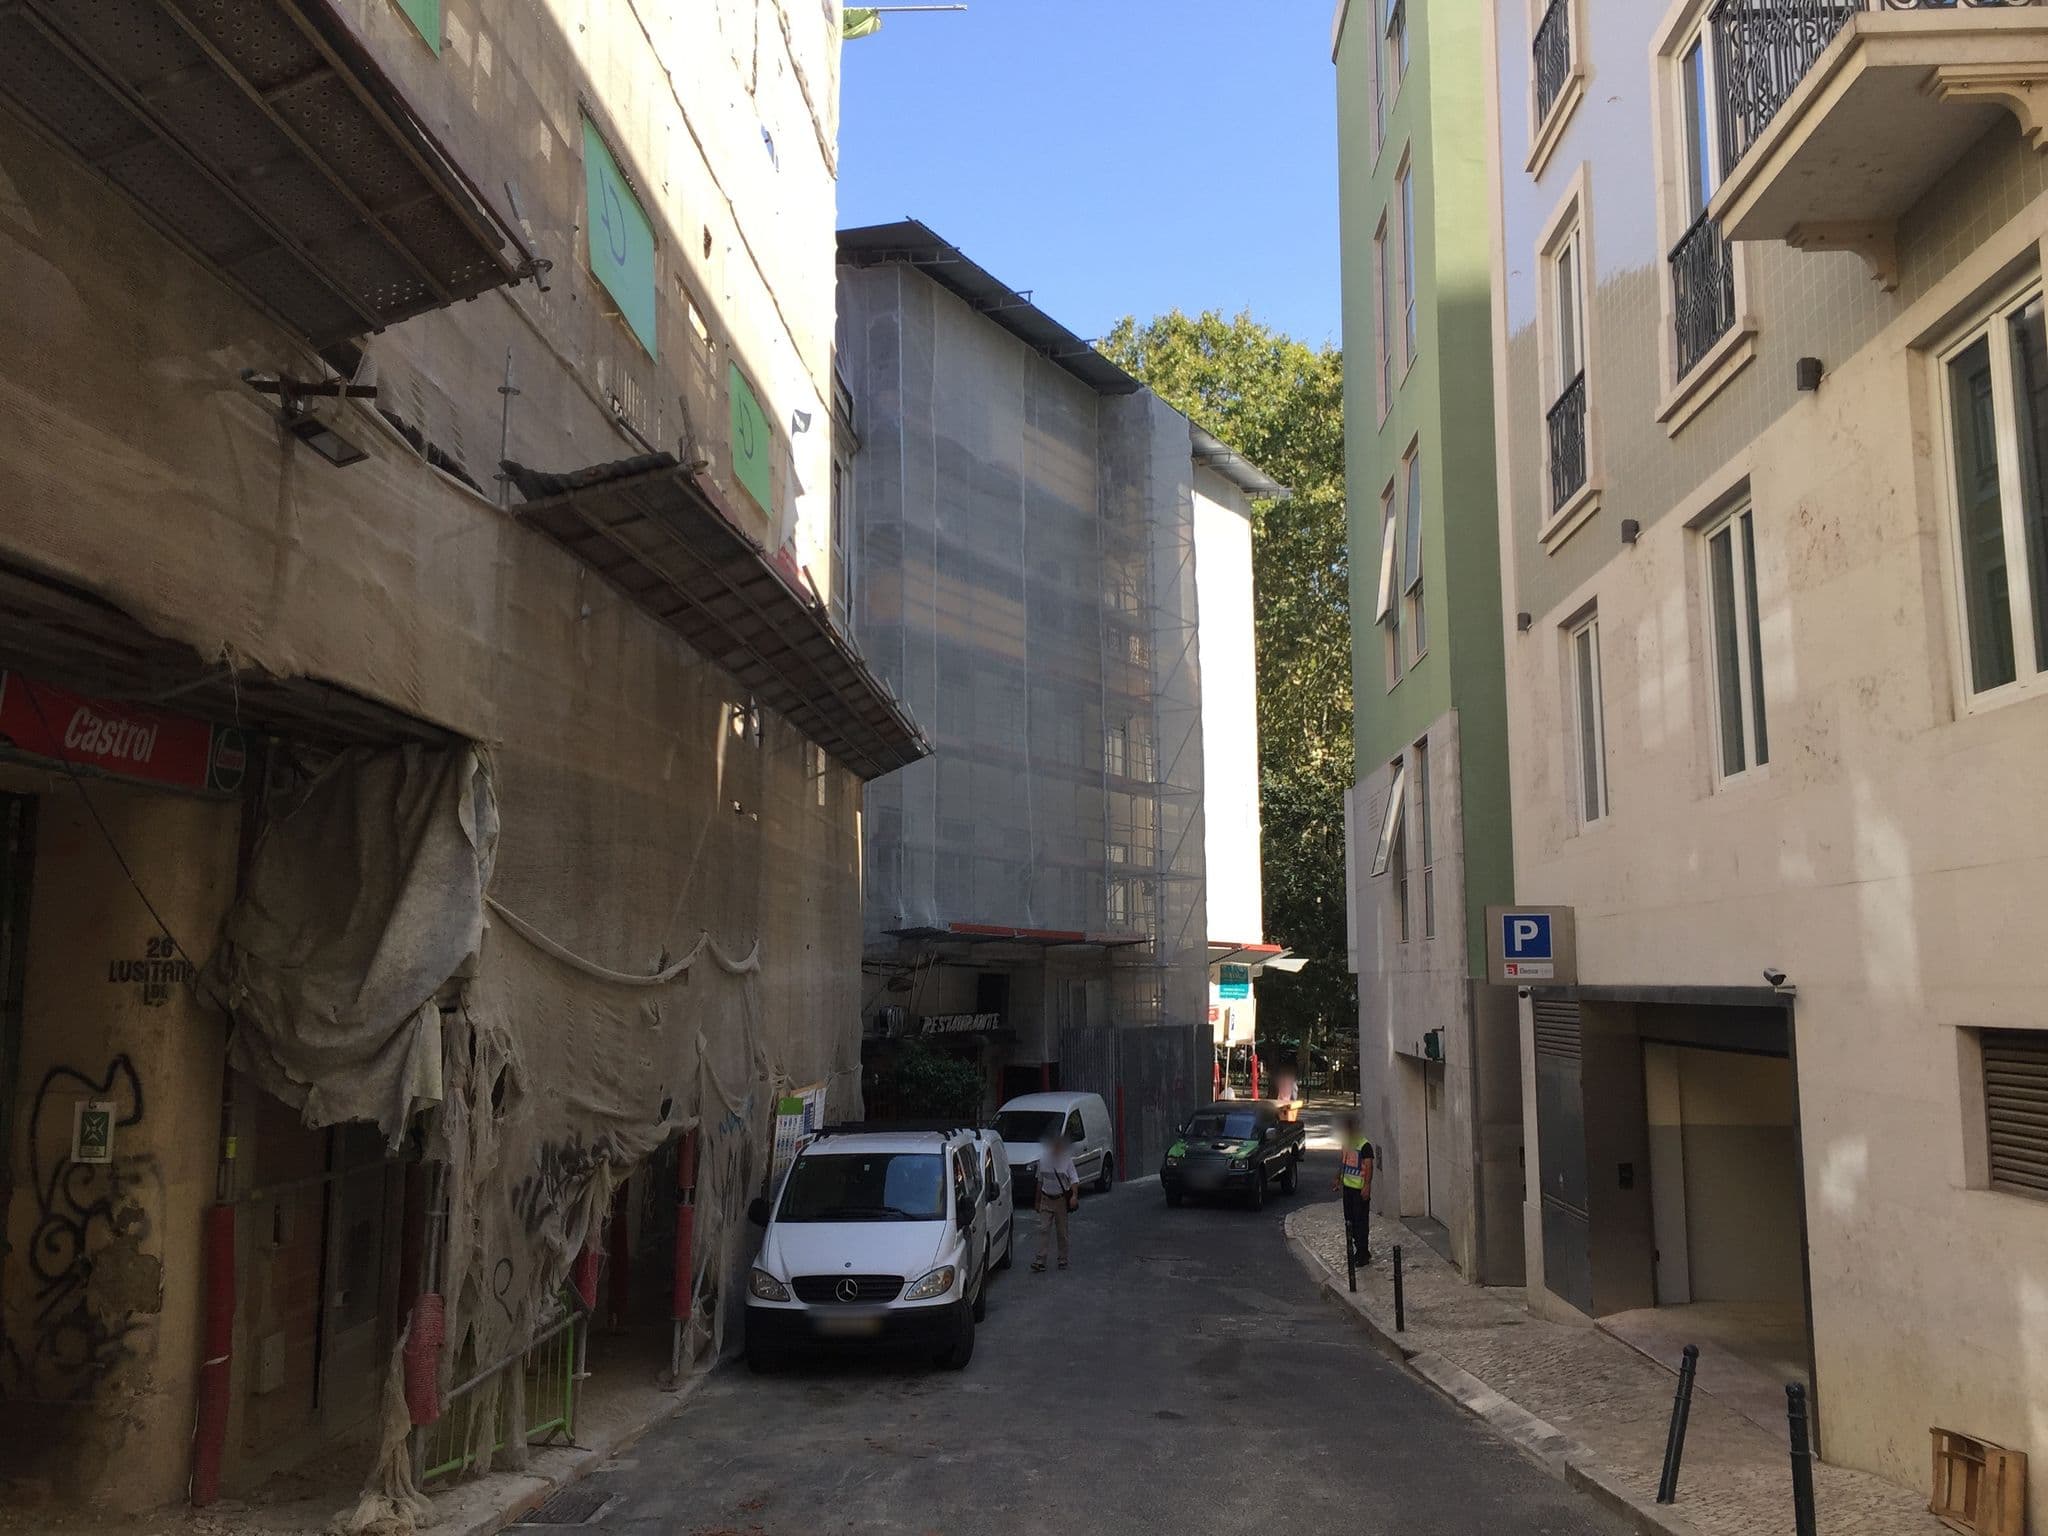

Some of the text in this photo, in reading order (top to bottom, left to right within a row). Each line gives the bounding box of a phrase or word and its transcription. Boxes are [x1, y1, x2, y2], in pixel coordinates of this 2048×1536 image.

[63, 706, 158, 763] Castrol
[1514, 920, 1539, 952] P
[922, 1013, 1000, 1033] RESTAURANTE
